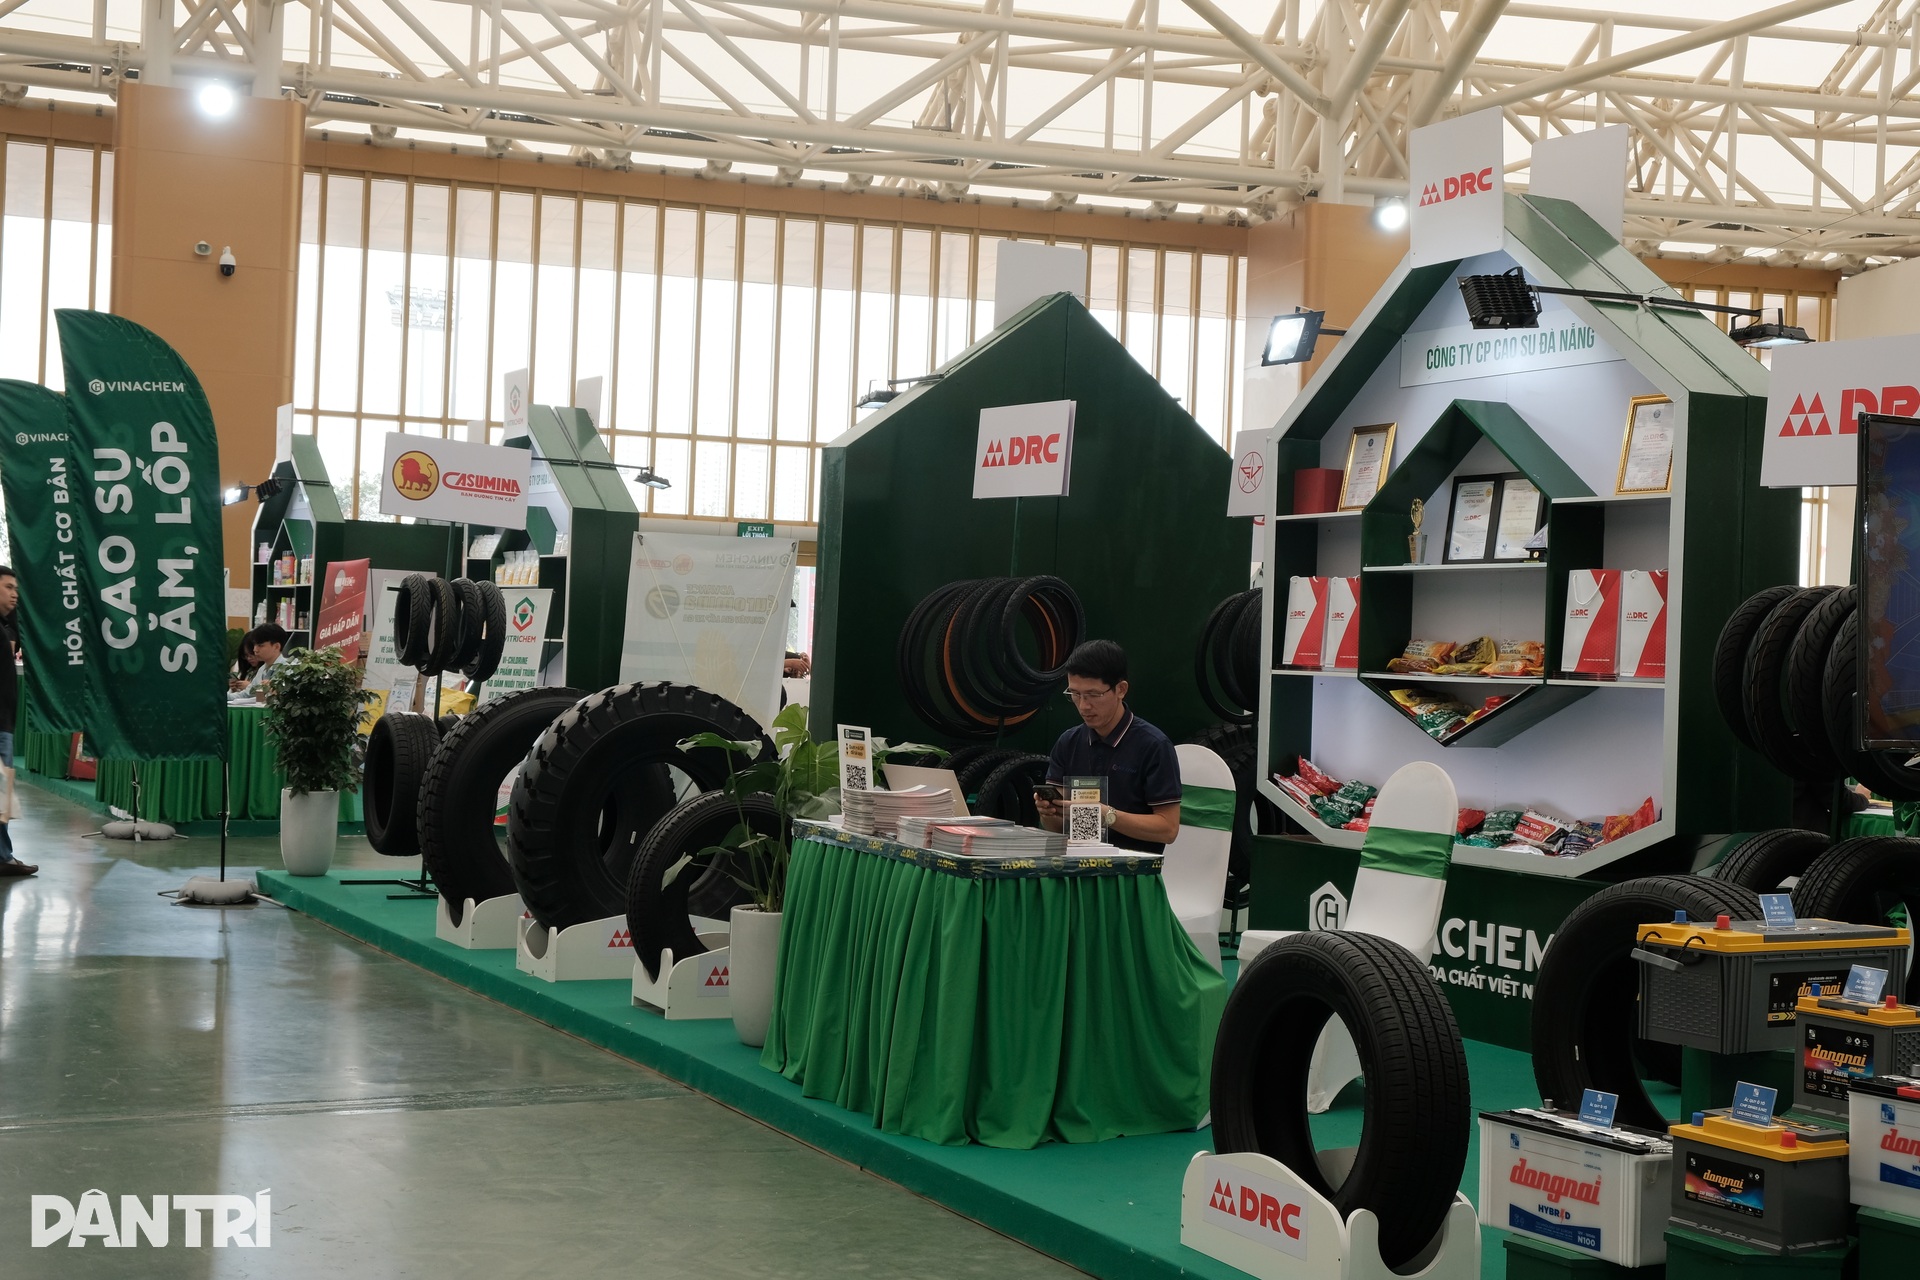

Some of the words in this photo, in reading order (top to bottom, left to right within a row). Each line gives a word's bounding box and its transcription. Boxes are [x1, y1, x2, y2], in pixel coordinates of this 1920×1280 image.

[1443, 167, 1493, 201] DRC
[1426, 345, 1456, 370] CÔNG
[1459, 343, 1475, 366] TY
[1476, 340, 1491, 363] CP
[1494, 336, 1518, 361] CAO
[1520, 333, 1536, 357] SU
[1539, 327, 1556, 354] ĐÀ
[1560, 322, 1595, 352] NẴNG
[106, 381, 186, 393] VINACHEM
[1008, 433, 1060, 466] DRC
[46, 457, 69, 504] BẢN
[93, 448, 133, 514] SU
[135, 421, 192, 524] LỐP
[442, 471, 522, 498] CASUMINA
[55, 511, 73, 543] CƠ
[53, 550, 80, 610] CHẤT
[98, 535, 139, 649] CAO
[148, 545, 199, 674] SĂM,
[319, 621, 332, 640] GIÁ
[332, 616, 346, 635] HẤP
[345, 611, 360, 631] DẪN
[62, 617, 84, 666] HÓA
[1012, 859, 1037, 869] DRC
[1089, 858, 1113, 868] DRC
[1449, 965, 1487, 990] CHẤT
[1487, 975, 1520, 999] VIỆT
[1522, 984, 1536, 1000] N
[1797, 982, 1842, 996] donai
[1811, 1044, 1867, 1067] dongnai
[1509, 1157, 1601, 1206] dongnai
[1703, 1169, 1744, 1189] dongnai
[1240, 1185, 1301, 1240] DRC
[1577, 1235, 1596, 1247] N100
